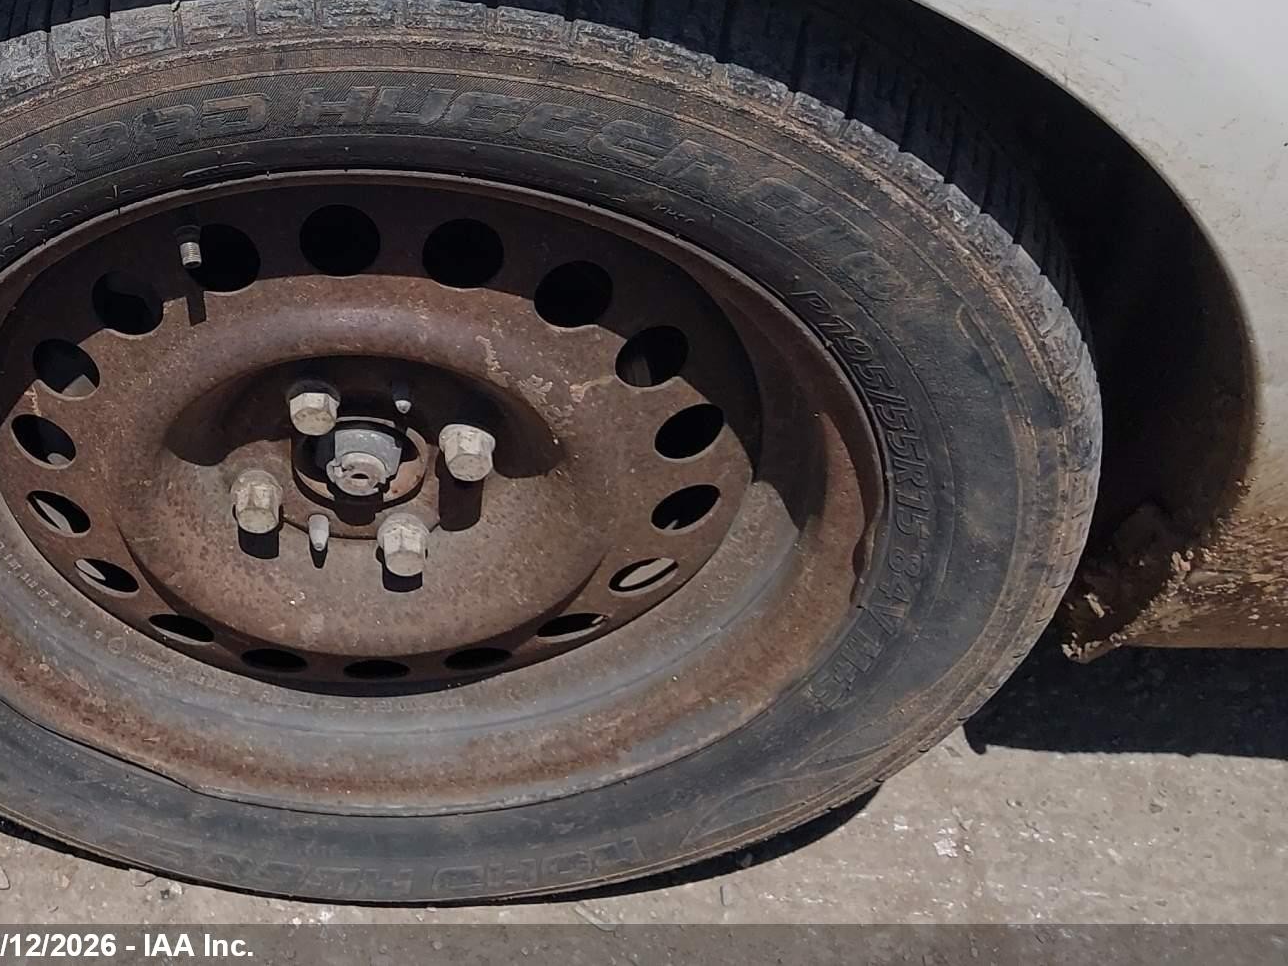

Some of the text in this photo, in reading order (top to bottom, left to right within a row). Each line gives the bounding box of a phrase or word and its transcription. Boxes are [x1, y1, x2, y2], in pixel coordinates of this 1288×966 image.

[8, 92, 270, 198] ROAD
[295, 85, 737, 190] HUGGER
[789, 289, 929, 539] P195/55R15
